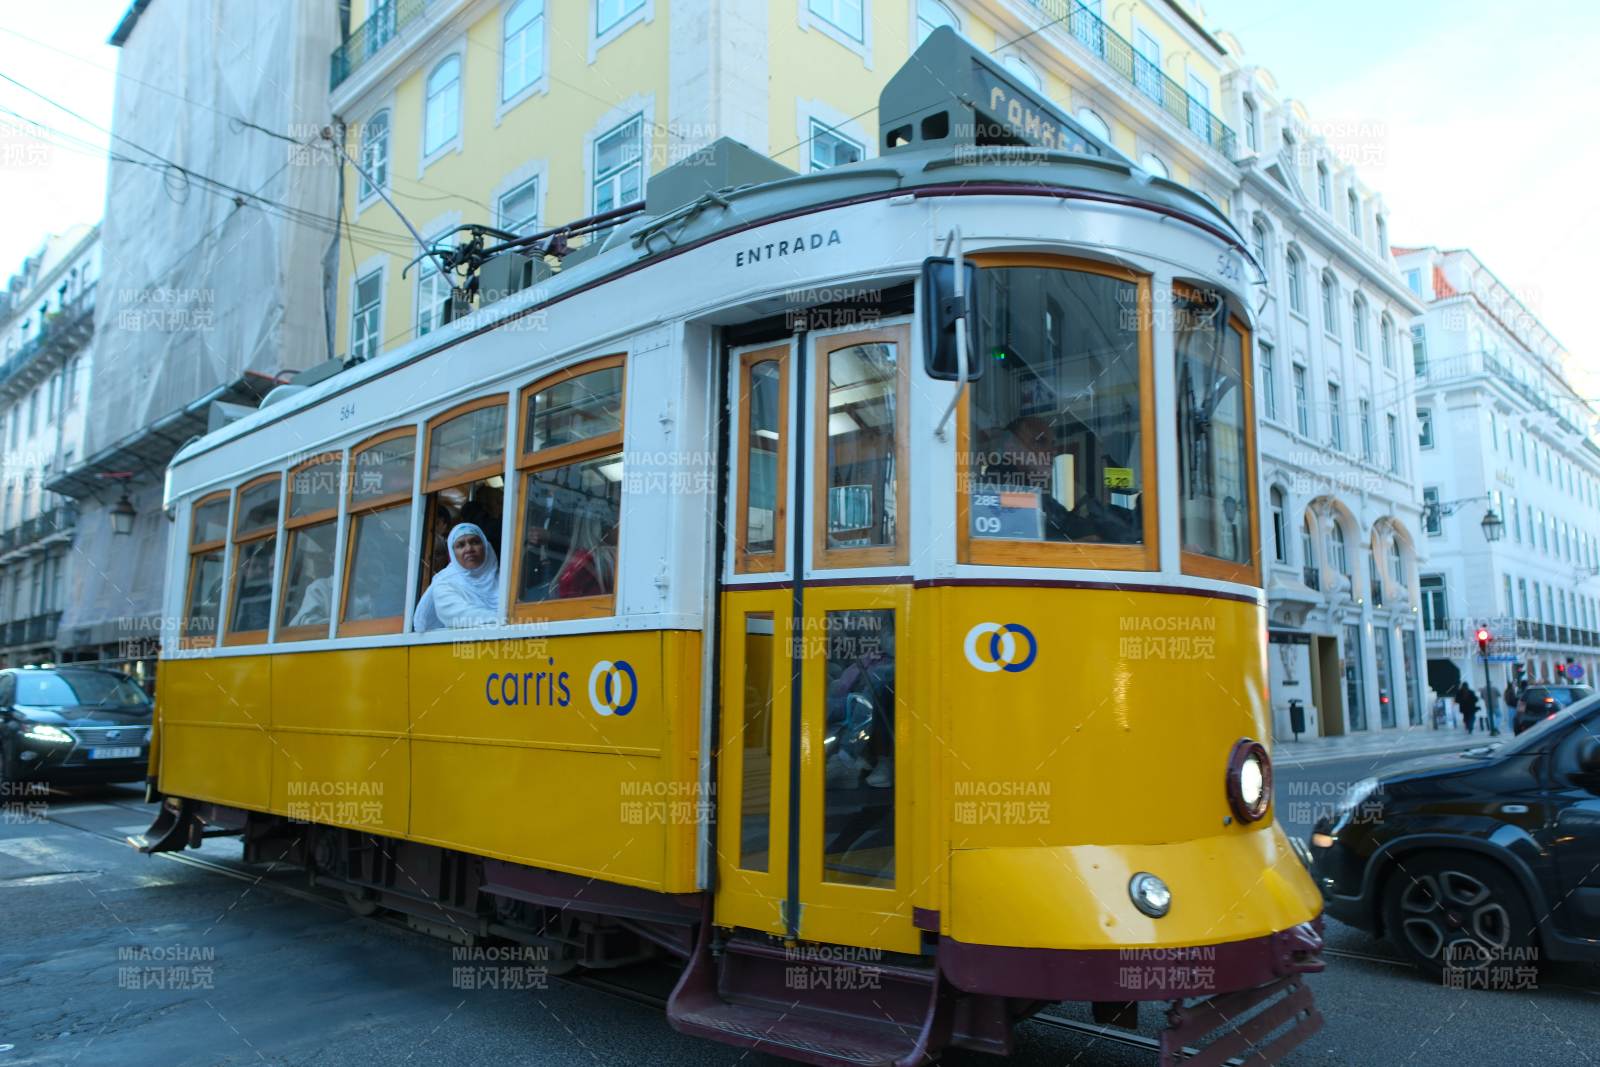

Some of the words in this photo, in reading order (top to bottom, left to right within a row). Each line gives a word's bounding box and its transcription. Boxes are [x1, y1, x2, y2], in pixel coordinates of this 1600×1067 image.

[735, 229, 841, 267] ENTRADA
[339, 403, 355, 421] 564
[974, 495, 1000, 506] 28E
[975, 516, 1001, 533] 09
[486, 656, 571, 707] carris
